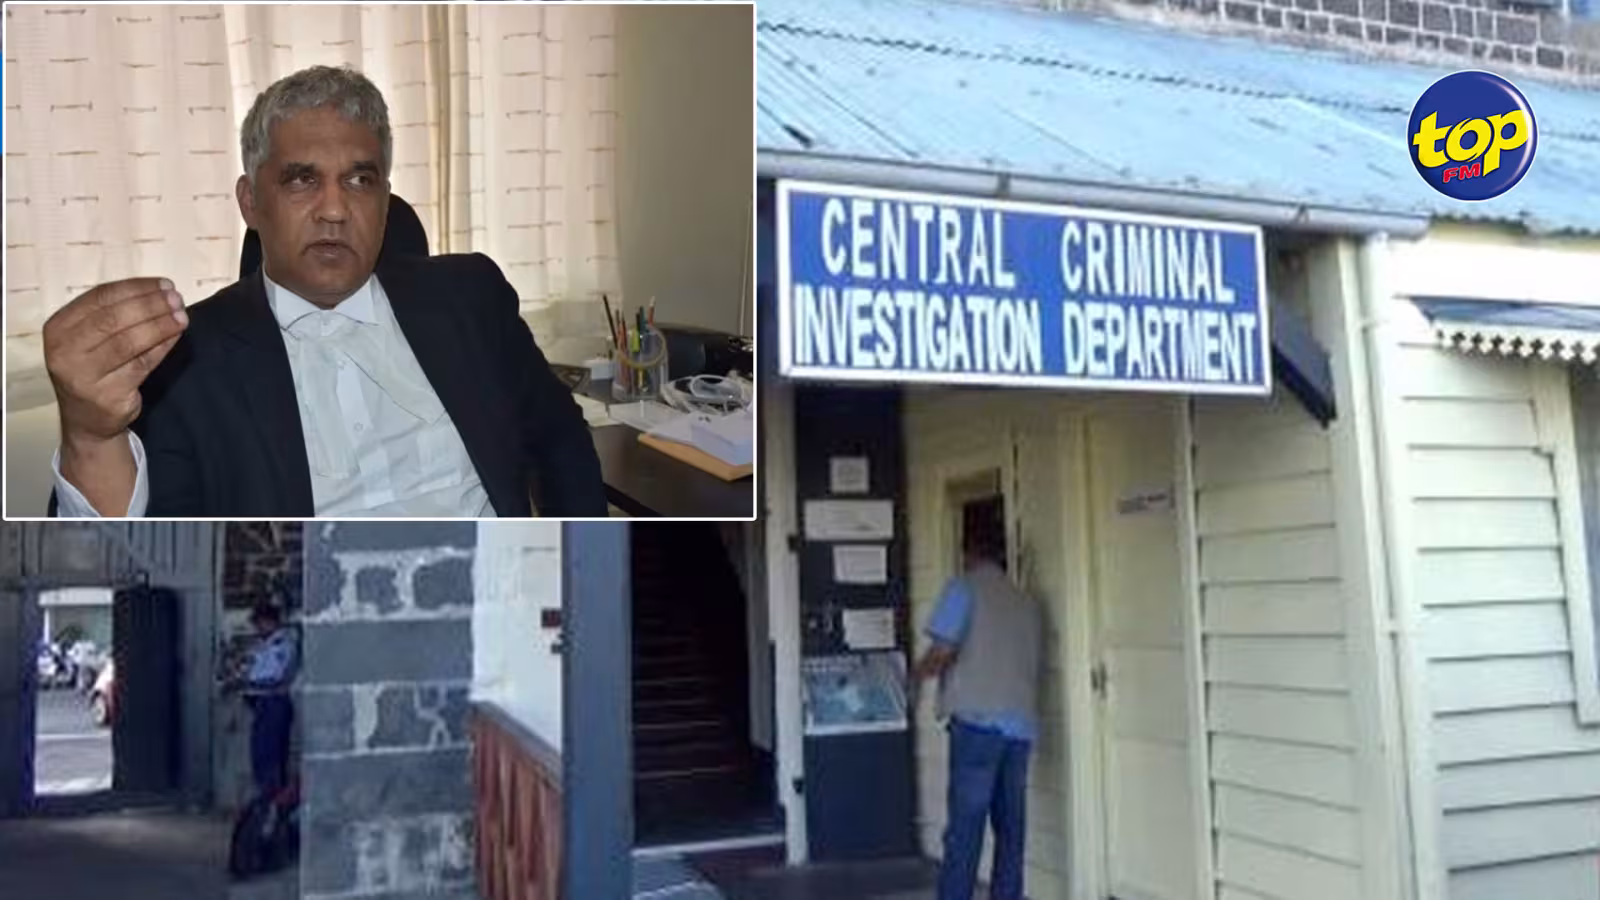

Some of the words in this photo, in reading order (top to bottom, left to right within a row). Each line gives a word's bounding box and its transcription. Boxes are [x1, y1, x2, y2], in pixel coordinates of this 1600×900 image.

[821, 198, 1016, 288] CENTRAL
[1061, 220, 1235, 304] CRIMINAL
[795, 283, 1042, 373] INVESTIGATION
[1063, 301, 1256, 383] DEPARTMENT
